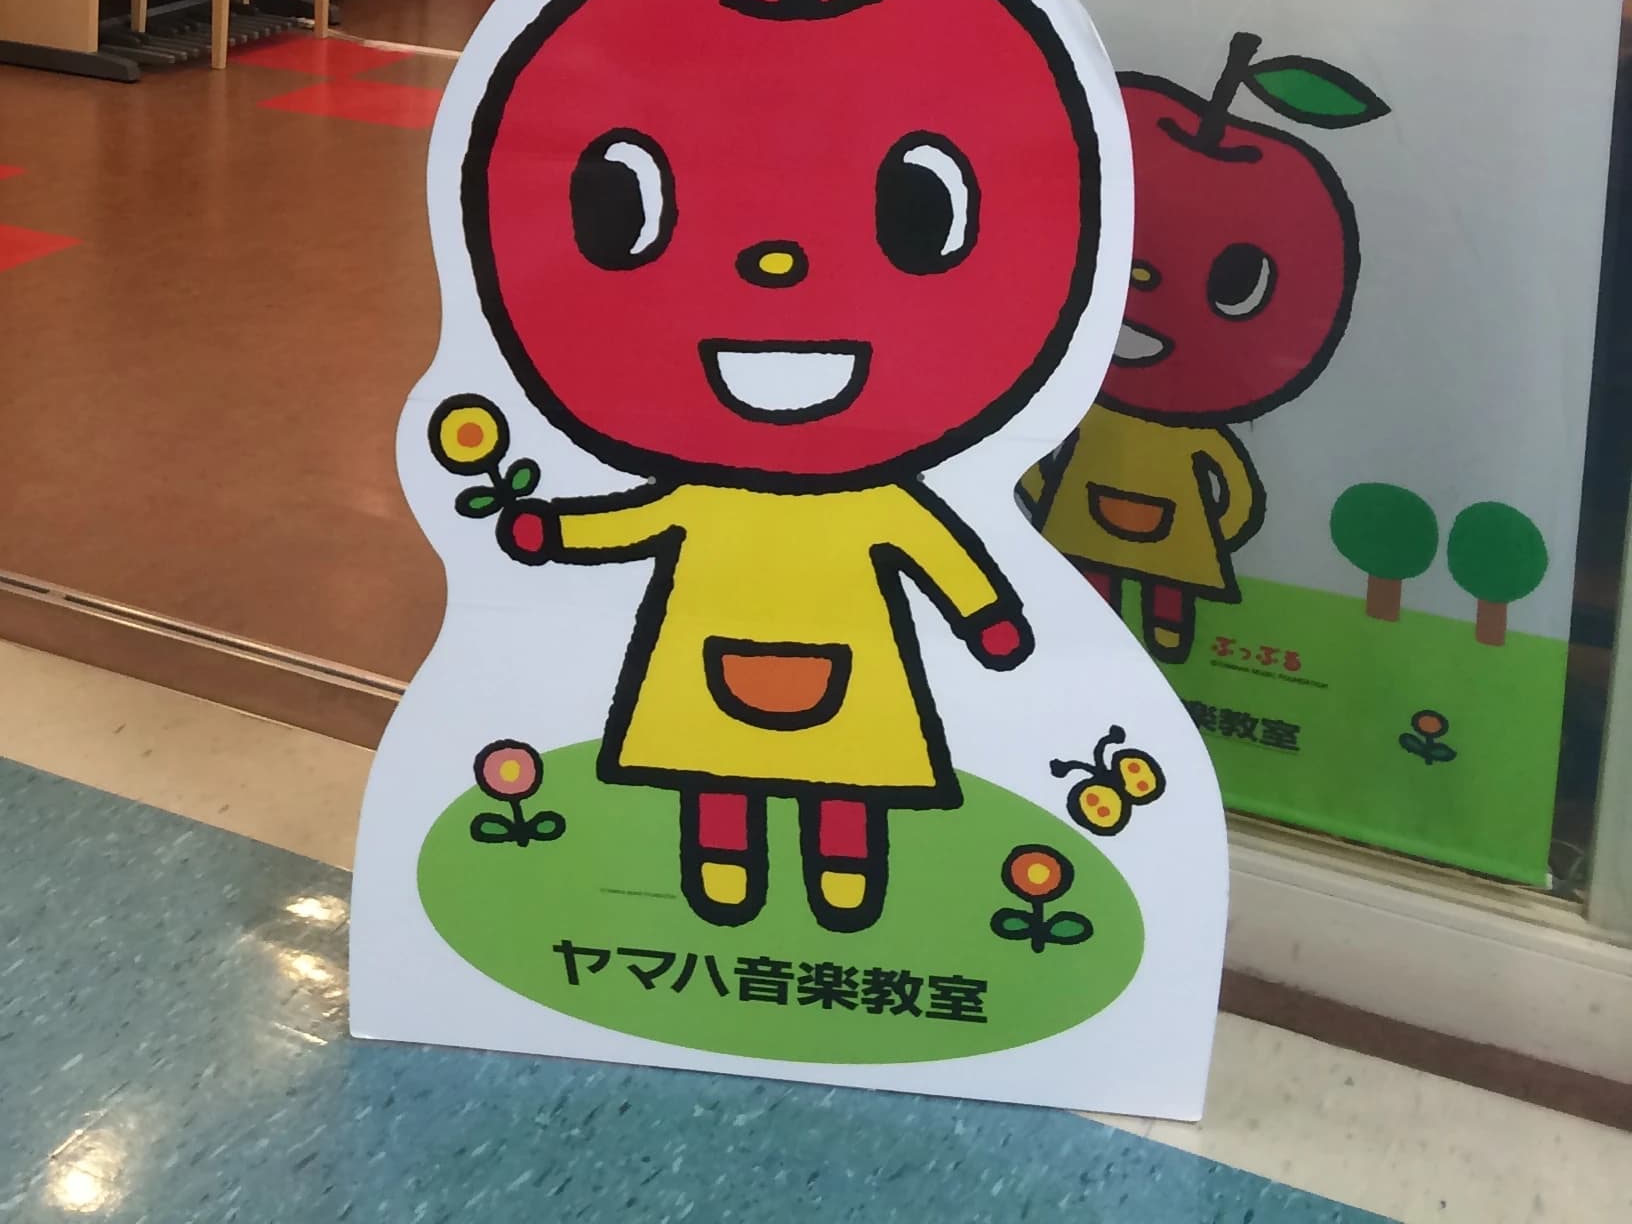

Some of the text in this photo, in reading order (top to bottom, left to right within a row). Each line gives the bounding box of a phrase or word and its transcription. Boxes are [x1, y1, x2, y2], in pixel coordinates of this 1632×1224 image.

[551, 938, 989, 1024] ヤマハ音楽教室
